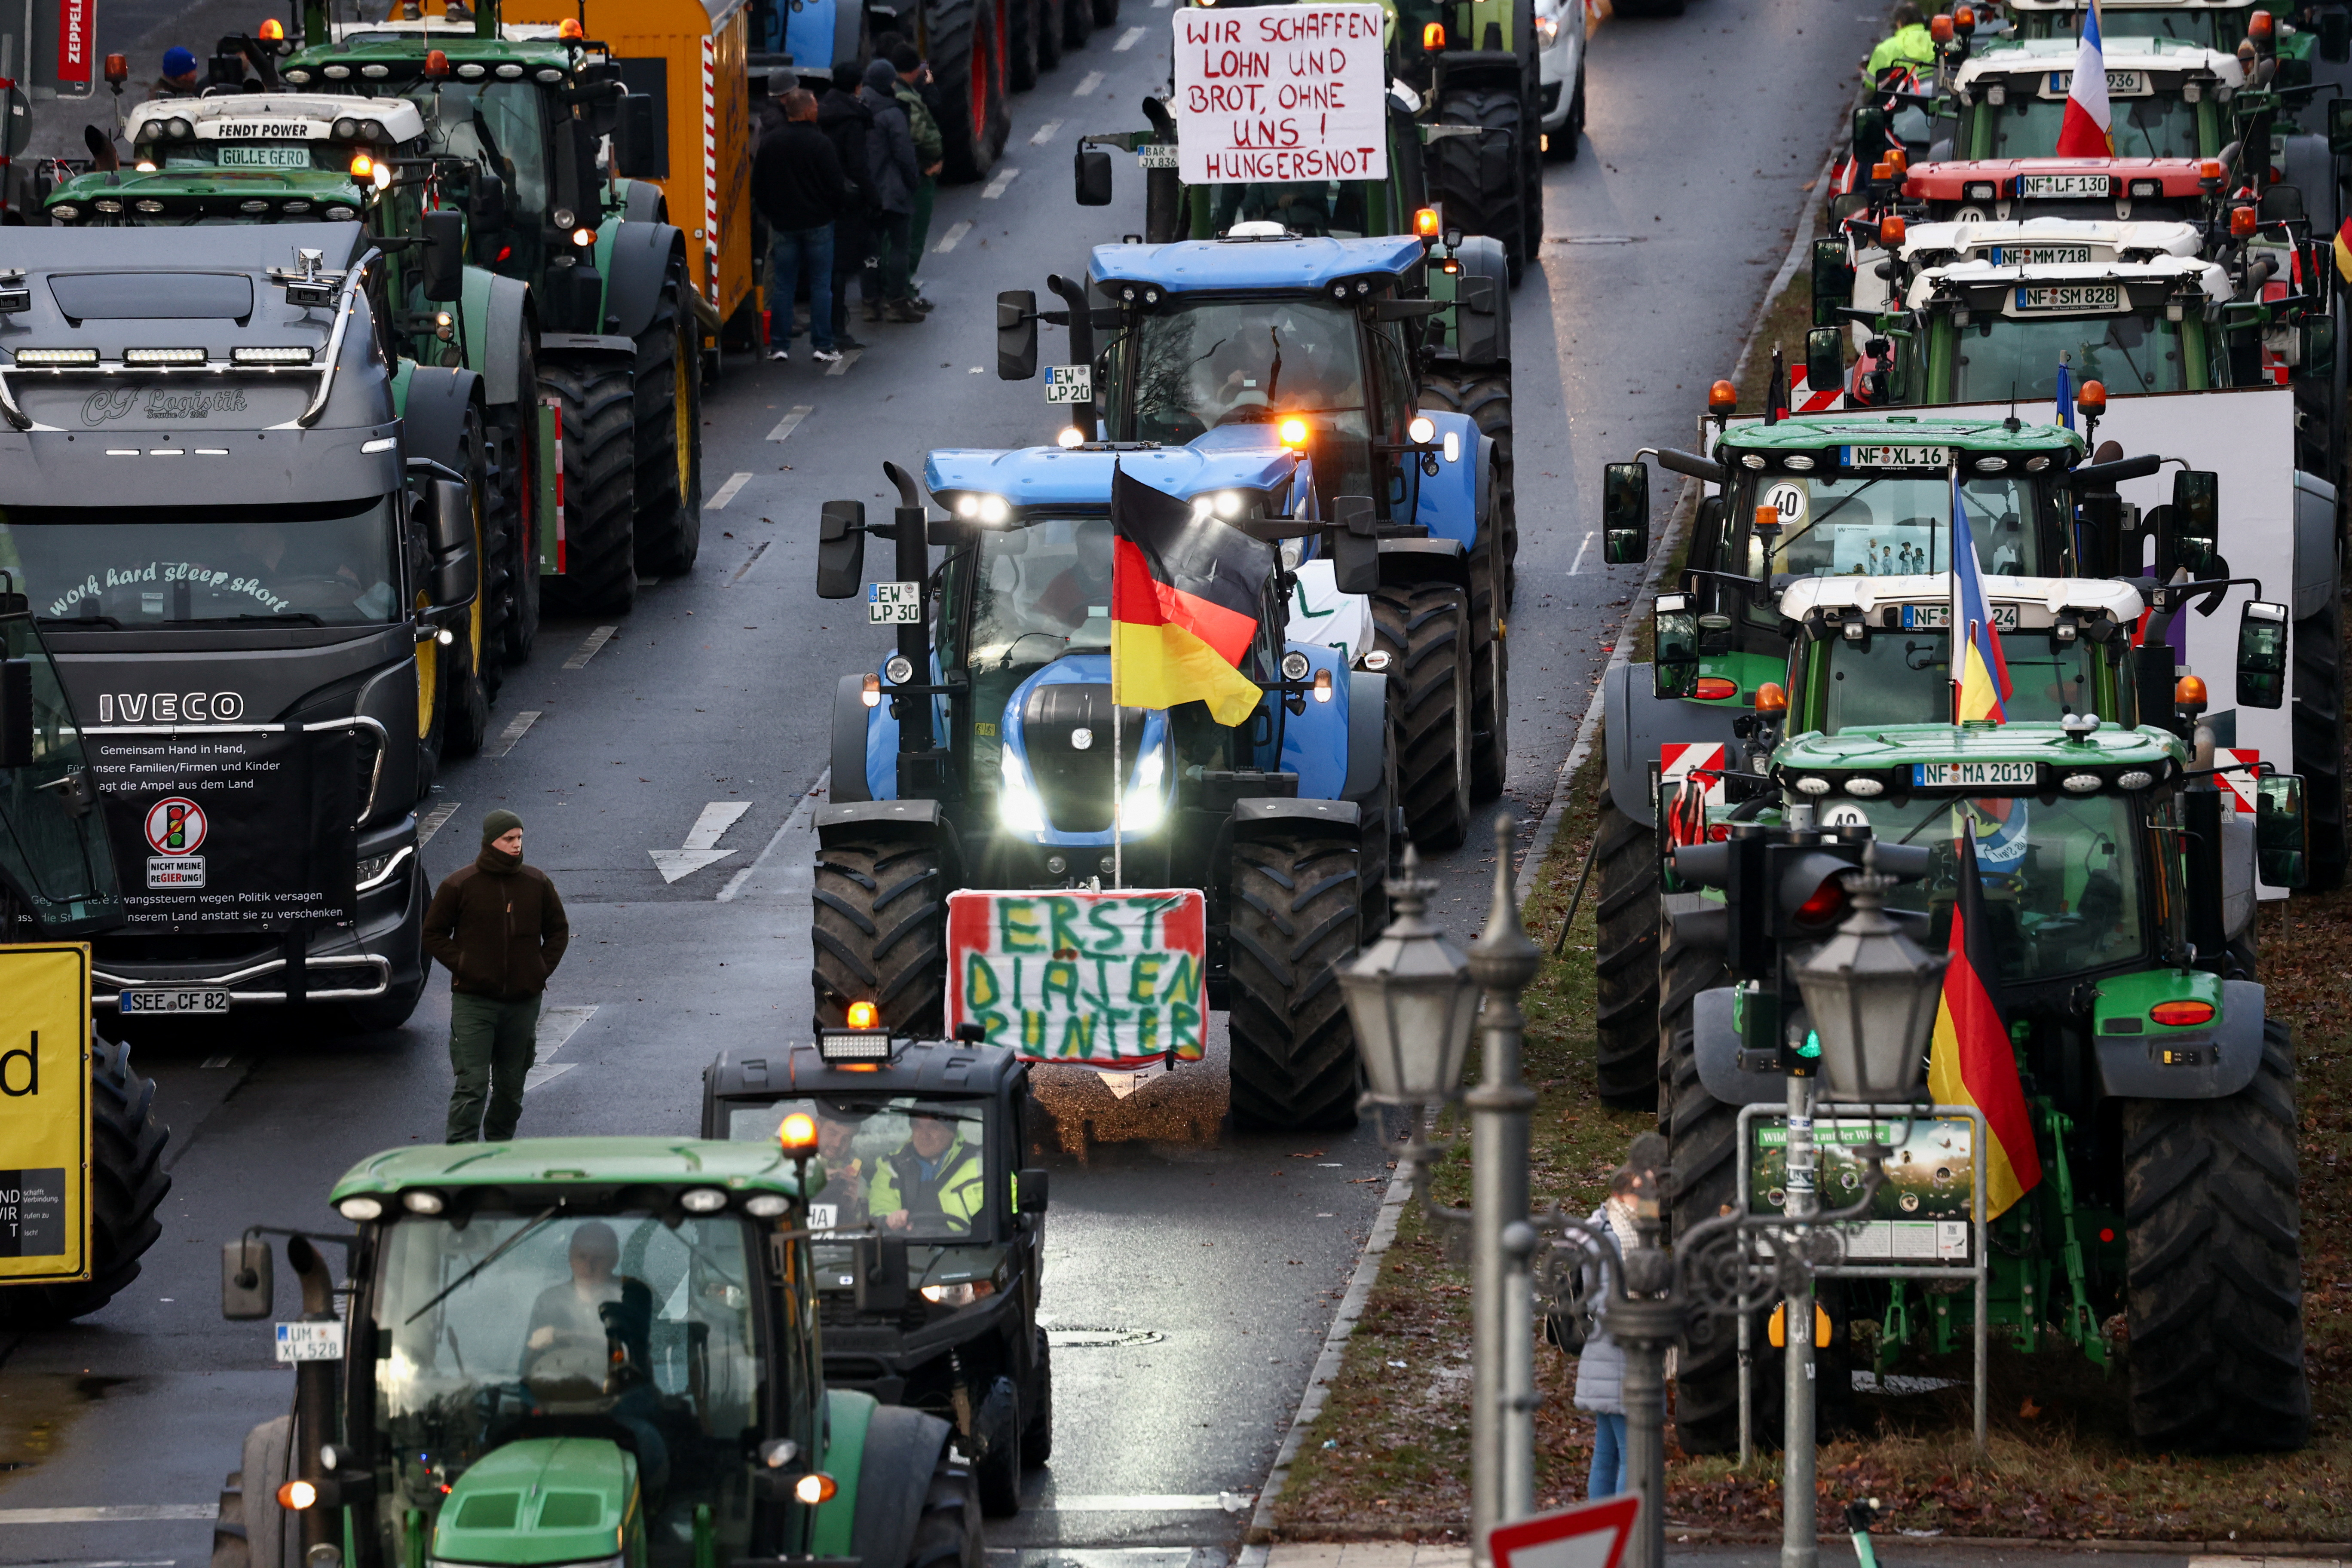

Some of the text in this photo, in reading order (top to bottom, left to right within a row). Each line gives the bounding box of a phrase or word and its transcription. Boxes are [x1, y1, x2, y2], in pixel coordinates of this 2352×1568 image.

[1187, 13, 1377, 44] WIR SCHAFFEN
[1204, 48, 1346, 78] LOHN UND
[1188, 82, 1345, 115] BROT, OHNE
[219, 124, 307, 137] FENDT POWER
[1234, 118, 1299, 146] UNS
[224, 149, 303, 165] GÜLLE GERO
[1146, 147, 1165, 156] BAR
[1142, 158, 1176, 167] JX 836
[1207, 147, 1375, 179] HUNGERSNOT
[2026, 178, 2107, 192] NF LF 130
[2003, 250, 2022, 263] NF
[2034, 249, 2054, 263] MM
[2058, 249, 2086, 263] 718
[2027, 289, 2048, 304] NF
[2060, 288, 2080, 304] SM
[2085, 288, 2115, 303] 828
[1054, 369, 1074, 384] EW
[1048, 385, 1089, 401] LP 20
[144, 388, 247, 419] Logistik
[1858, 447, 1880, 464] NF
[1893, 448, 1915, 464] XL
[1920, 448, 1941, 464] 16
[1773, 490, 1798, 517] 40
[50, 562, 289, 616] work hard sleep short
[879, 586, 900, 602] EW
[871, 604, 918, 621] LP 30
[1915, 609, 1939, 625] NF
[100, 692, 244, 722] IVECO
[101, 744, 246, 755] Gemeinsam Hand in Hand,
[130, 763, 217, 773] Familien/Firmen
[221, 762, 241, 772] und
[246, 761, 280, 771] Kinder
[1926, 765, 1948, 783] NF
[1963, 764, 1985, 782] MA
[1991, 764, 2034, 782] 2019
[99, 781, 117, 792] agt
[120, 781, 137, 791] die
[141, 780, 175, 792] Ampel
[201, 780, 224, 790] dem
[229, 779, 254, 789] Land
[200, 894, 234, 904] wegen
[239, 892, 270, 902] Politik
[274, 892, 322, 902] versagen
[172, 911, 197, 921] Land
[202, 911, 239, 920] anstatt
[243, 911, 257, 919] sie
[278, 908, 343, 919] verschenken
[997, 896, 1184, 953] ERST
[132, 994, 166, 1010] SEE
[178, 993, 200, 1009] CF
[205, 992, 226, 1009] 82
[973, 991, 1202, 1060] RUNTER
[291, 1327, 312, 1341] UM
[283, 1342, 337, 1360] XL 528
